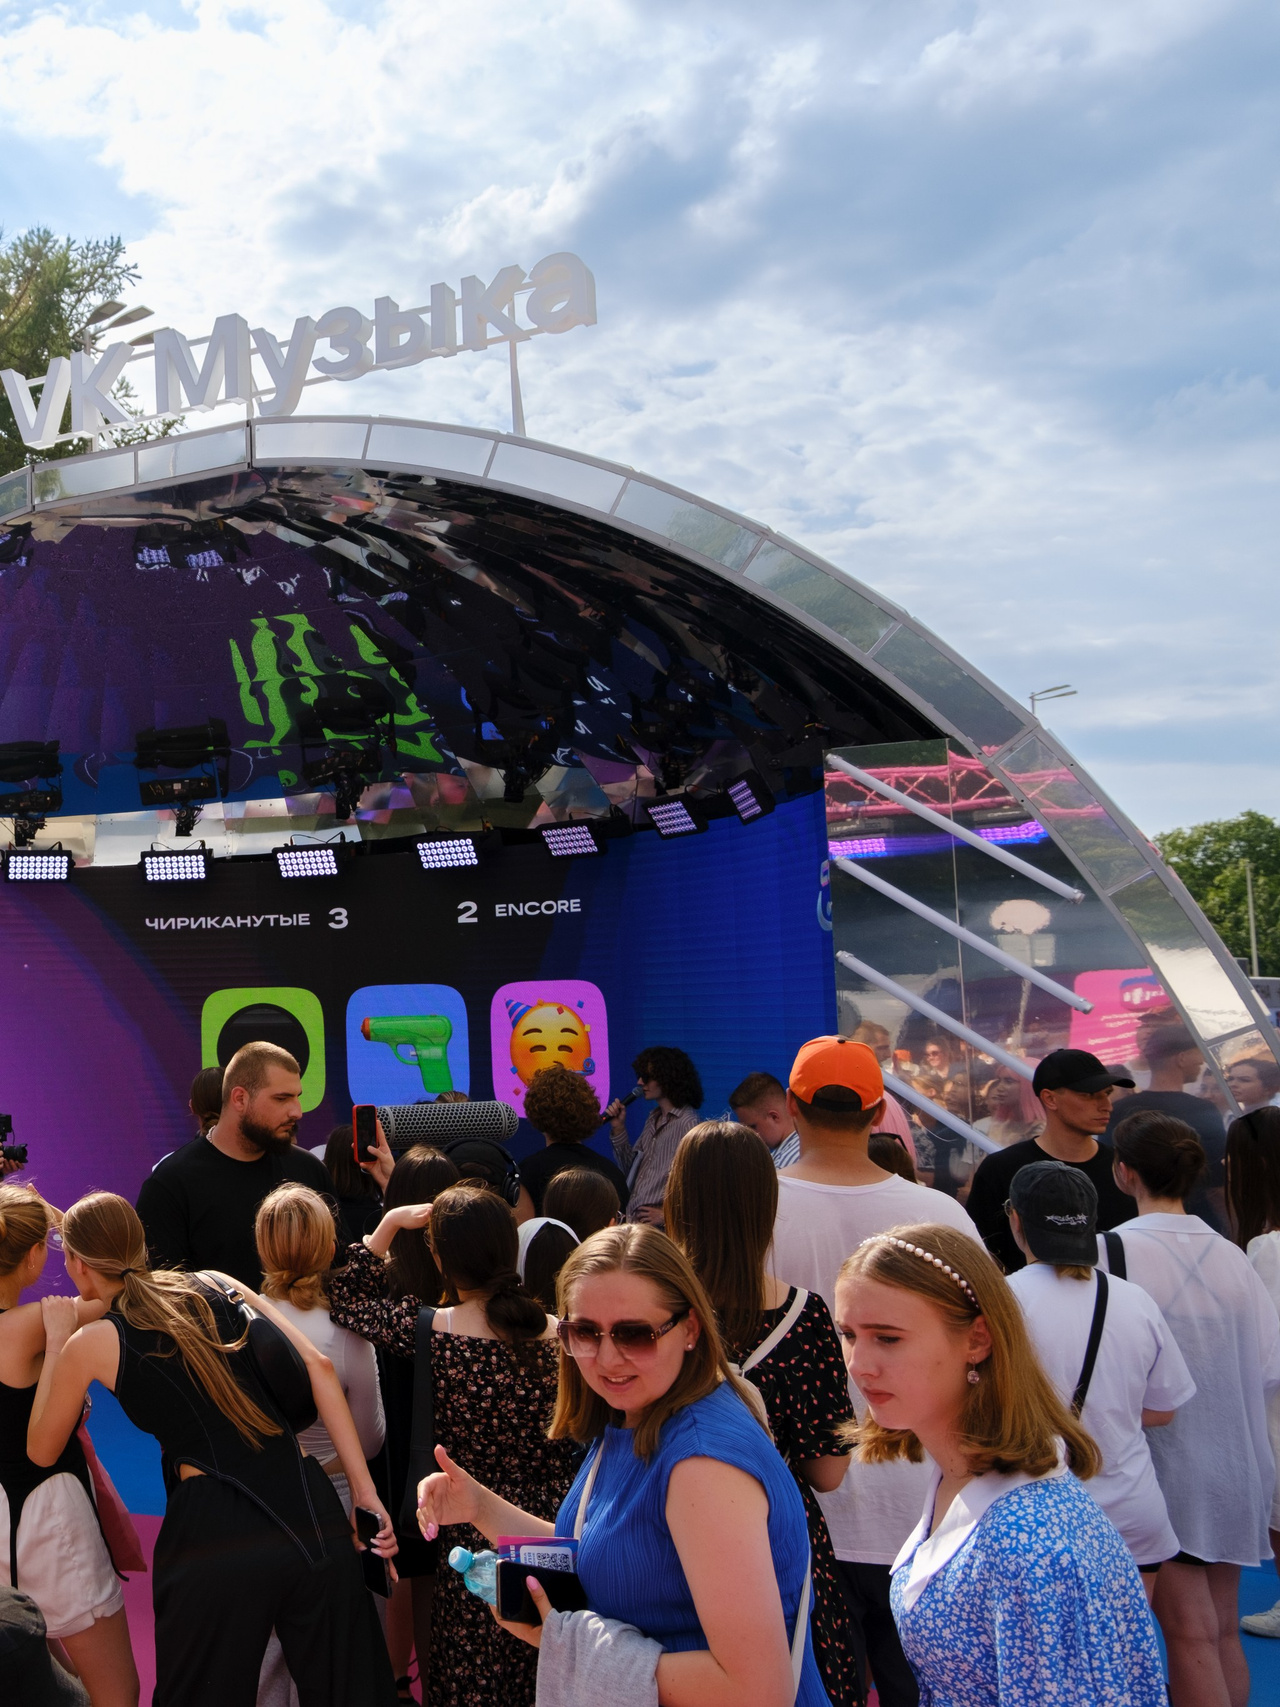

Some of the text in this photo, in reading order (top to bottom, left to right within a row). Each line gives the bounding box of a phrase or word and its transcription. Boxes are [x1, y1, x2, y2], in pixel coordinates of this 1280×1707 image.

[0, 252, 597, 449] VK Музыка
[145, 907, 349, 930] ЧИРИКАНУТЫЕ 3
[457, 898, 582, 924] 2 ENCORE
